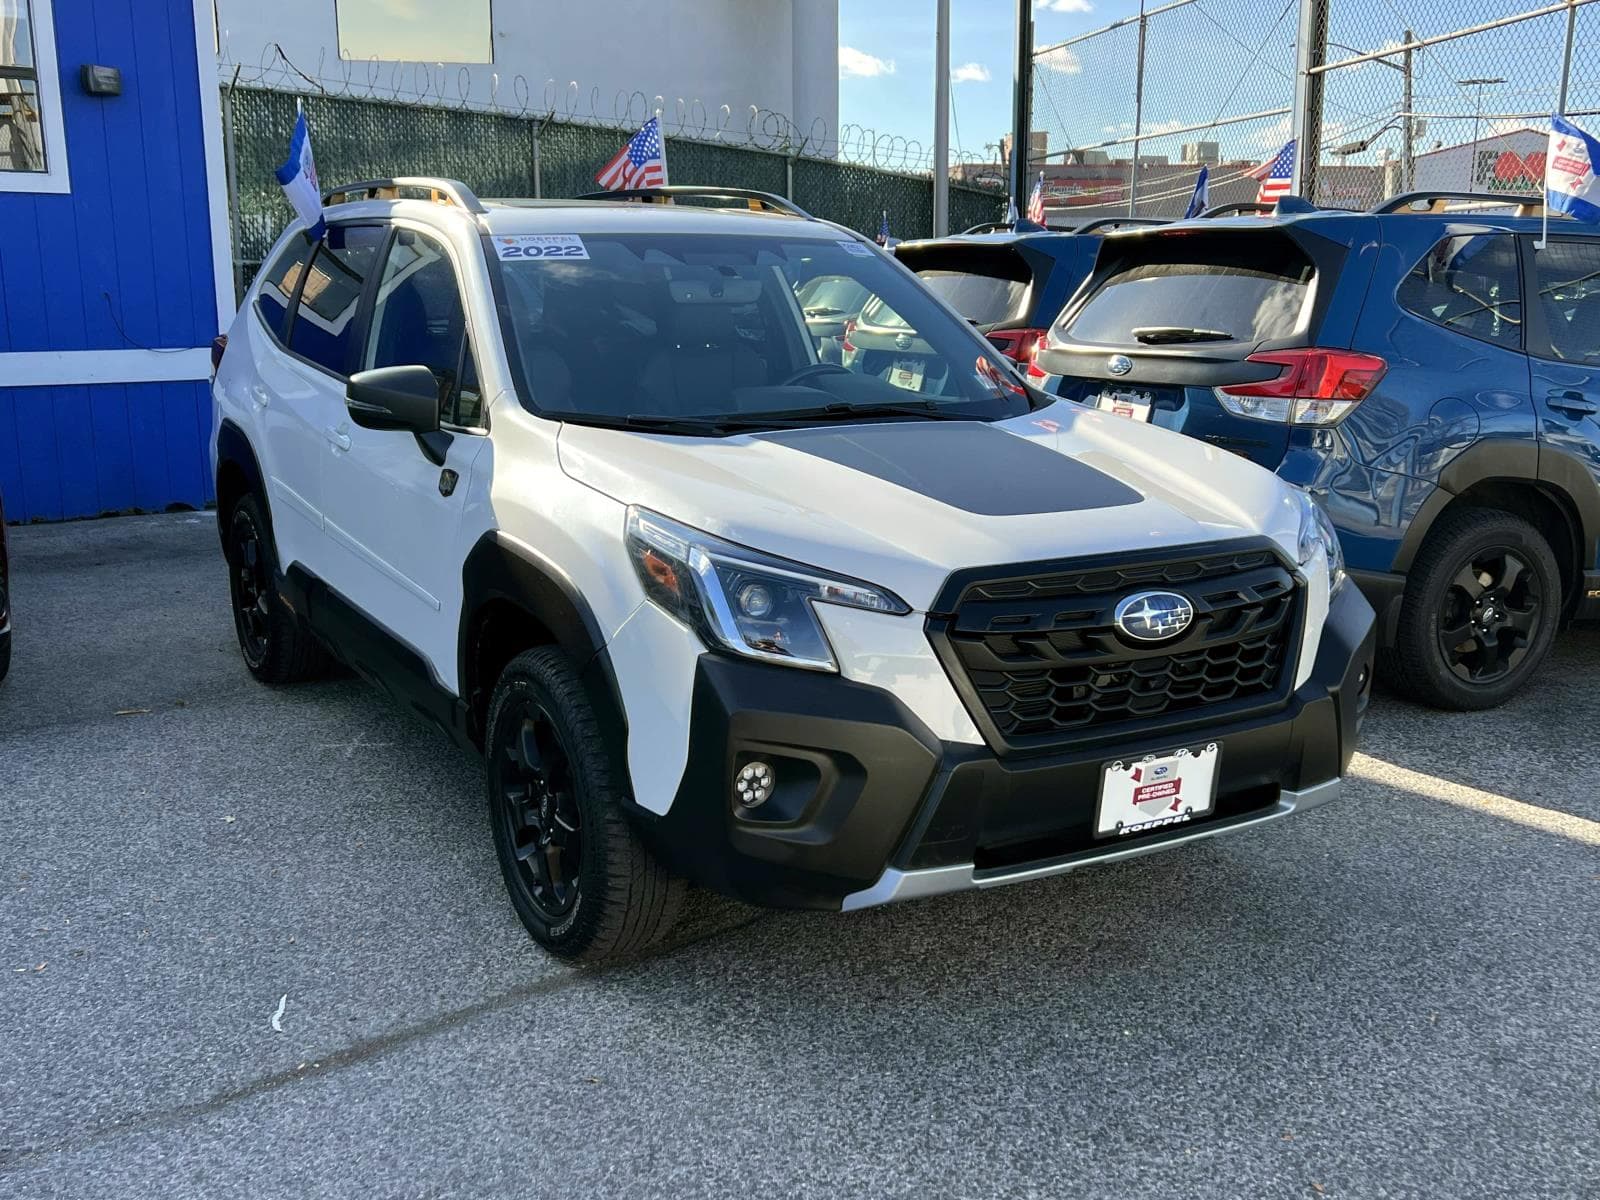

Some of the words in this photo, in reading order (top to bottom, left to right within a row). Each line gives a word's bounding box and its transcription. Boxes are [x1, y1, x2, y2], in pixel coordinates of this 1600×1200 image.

[502, 245, 584, 258] 2022
[1137, 788, 1176, 801] PRE-OWNED
[1141, 782, 1174, 794] CERTIFIED
[1118, 814, 1192, 835] KOEPPEL
